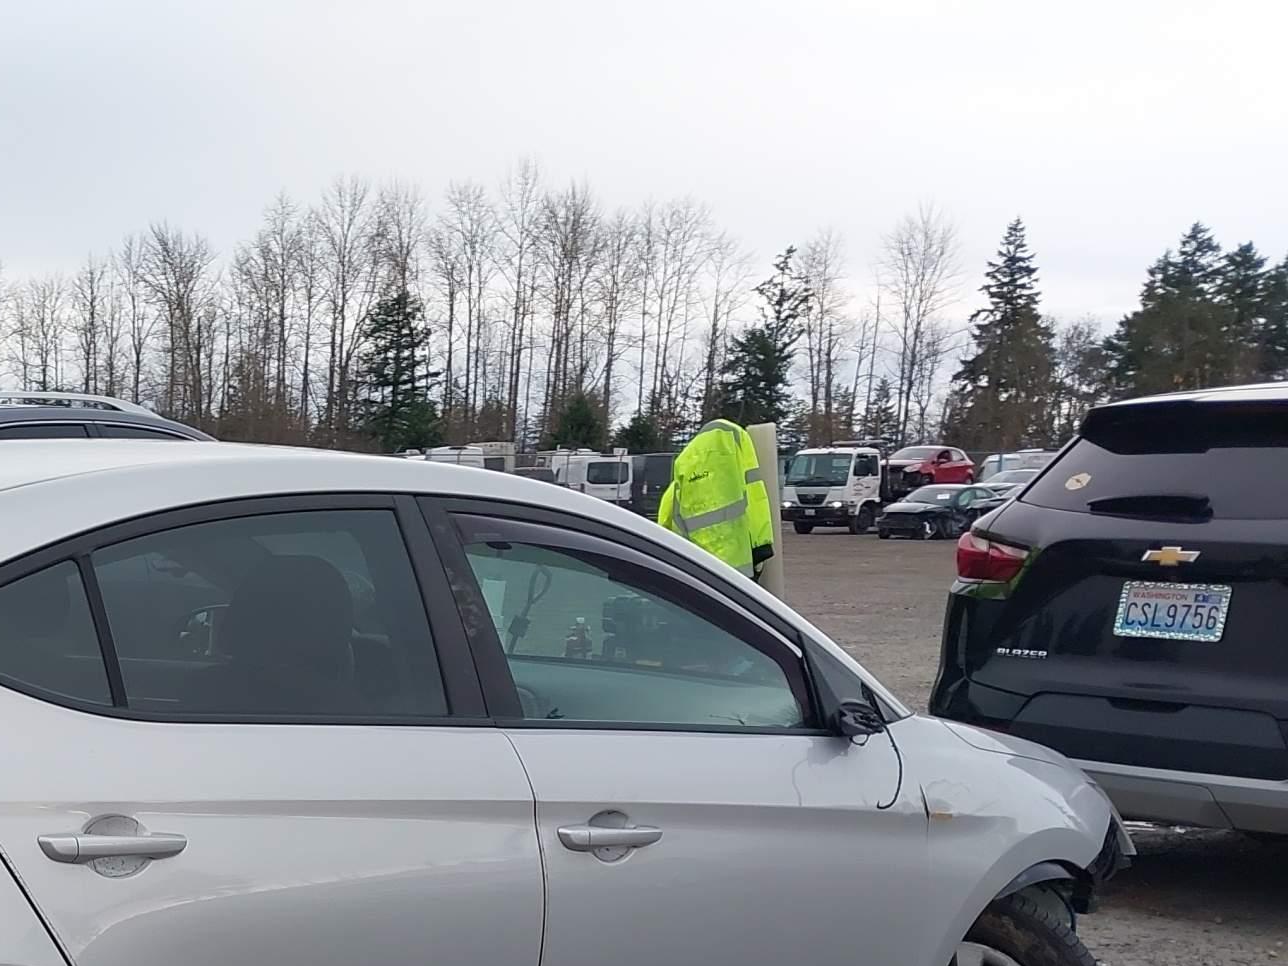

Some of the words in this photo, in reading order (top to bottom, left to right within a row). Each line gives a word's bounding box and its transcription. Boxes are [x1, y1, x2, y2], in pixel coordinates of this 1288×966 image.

[1132, 592, 1189, 602] WASHINGTON
[1125, 601, 1220, 631] CSL9756
[996, 647, 1048, 660] BLAZER
